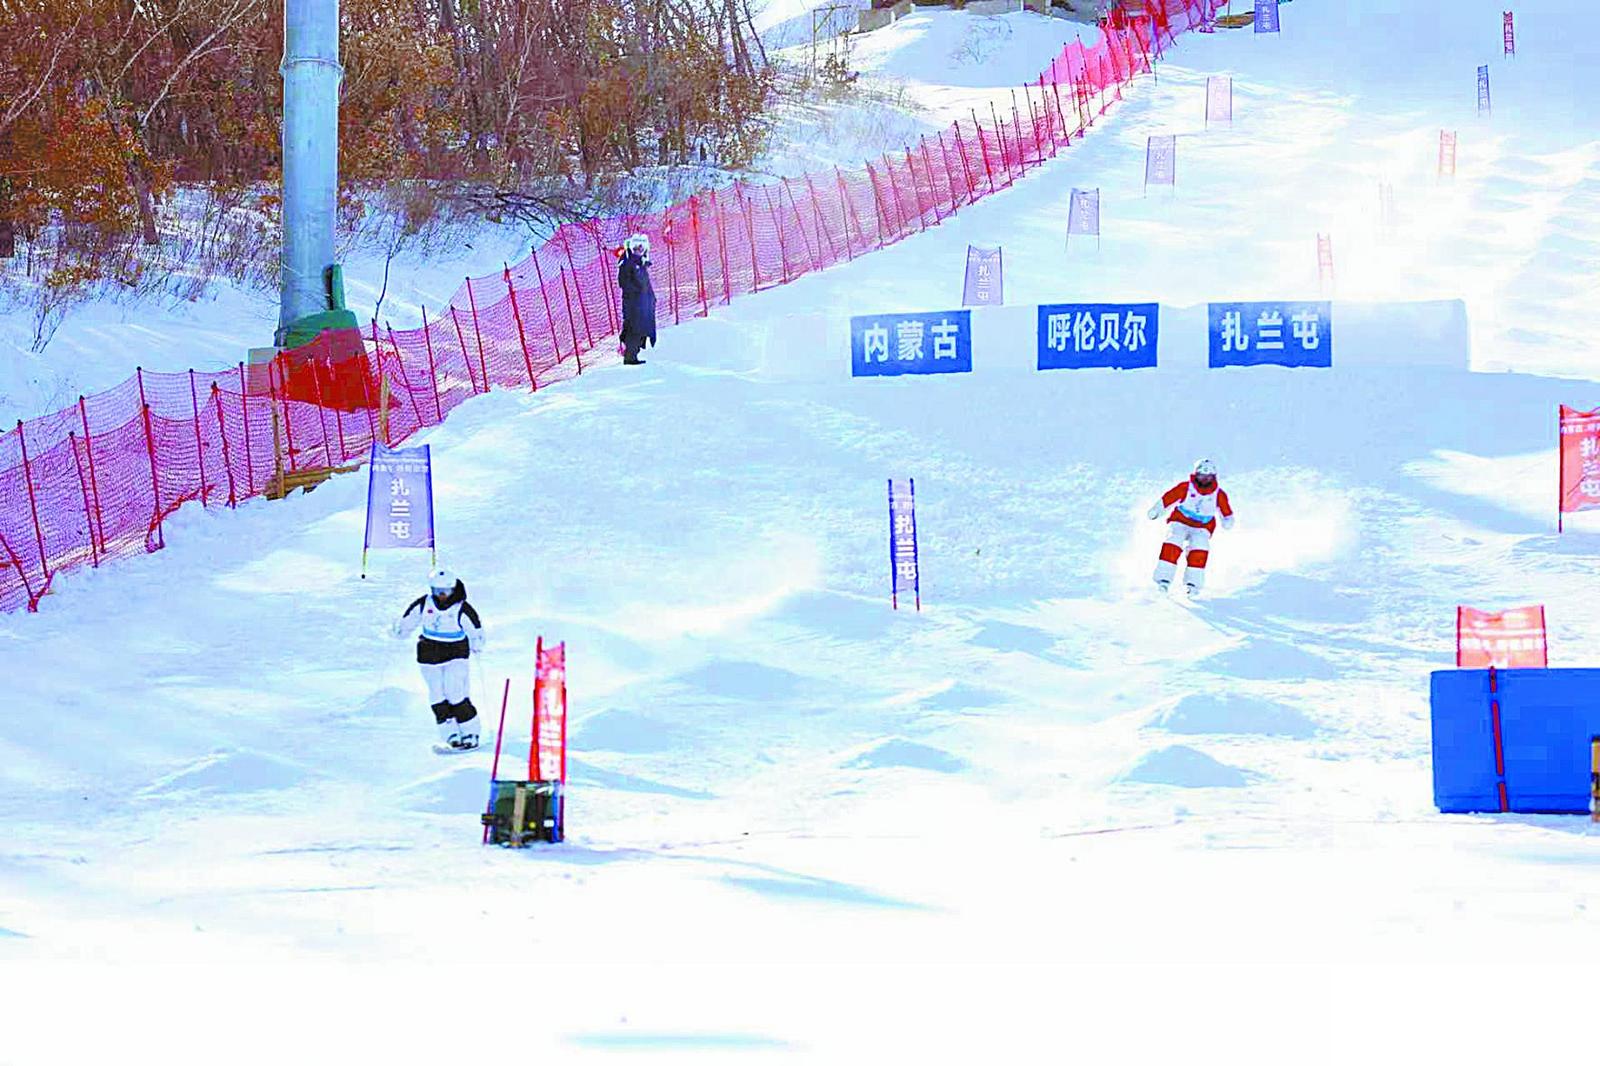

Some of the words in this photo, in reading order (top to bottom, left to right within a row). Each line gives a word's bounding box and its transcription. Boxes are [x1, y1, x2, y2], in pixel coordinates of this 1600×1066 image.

[864, 319, 959, 364] 内蒙古
[1048, 311, 1147, 351] 呼伦贝尔
[1222, 310, 1319, 352] 扎兰屯
[389, 478, 411, 539] 扎兰屯
[894, 514, 916, 580] 扎兰屯
